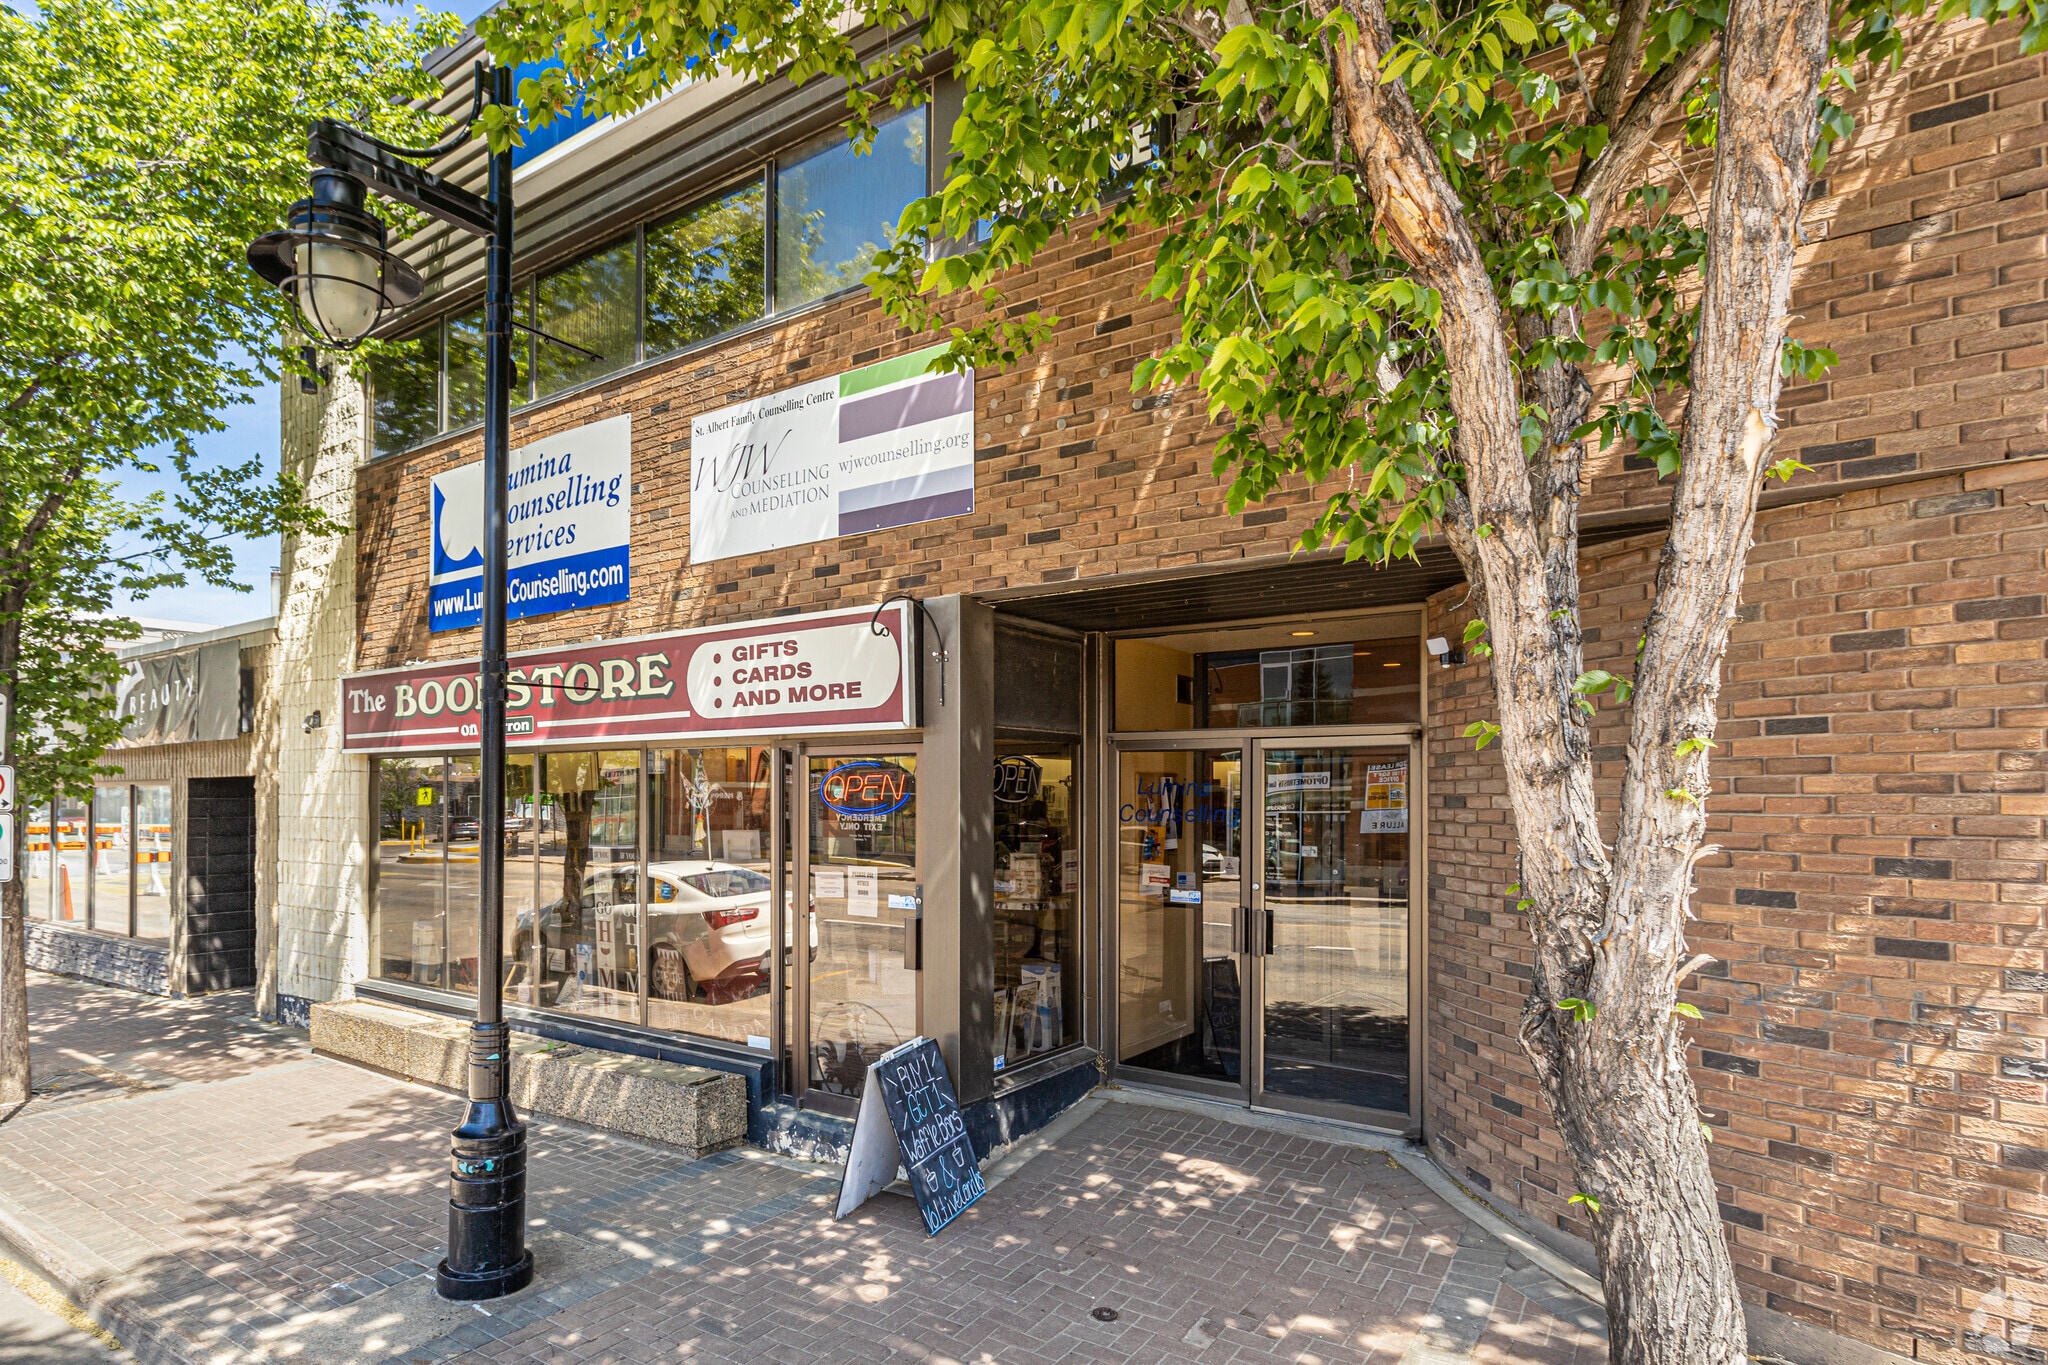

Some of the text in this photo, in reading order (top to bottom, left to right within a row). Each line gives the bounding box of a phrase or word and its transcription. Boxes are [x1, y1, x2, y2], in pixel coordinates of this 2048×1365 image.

[695, 390, 835, 438] St. Albert Family Counselling Centre
[694, 429, 792, 493] WJW
[838, 431, 970, 474] wjwcounselling.org
[508, 453, 571, 491] umina
[731, 463, 829, 500] COUNSELLING
[508, 473, 623, 524] ounselling
[730, 484, 829, 519] AND MEDIATION
[507, 523, 576, 558] ervices
[434, 564, 623, 617] www.LuCounselling.com
[732, 640, 799, 662] GIFTS
[732, 661, 812, 685] CARDS
[130, 675, 195, 716] BEAUTY
[348, 689, 386, 714] The
[732, 681, 862, 708] AND MORE
[460, 723, 479, 736] on
[824, 774, 905, 802] OPEN
[994, 764, 1041, 793] OPEN
[1137, 777, 1211, 797] Lumina
[1120, 804, 1240, 829] Counselling
[596, 901, 612, 915] GO
[897, 1053, 935, 1095] BUY 1
[908, 1082, 946, 1123] GET 1
